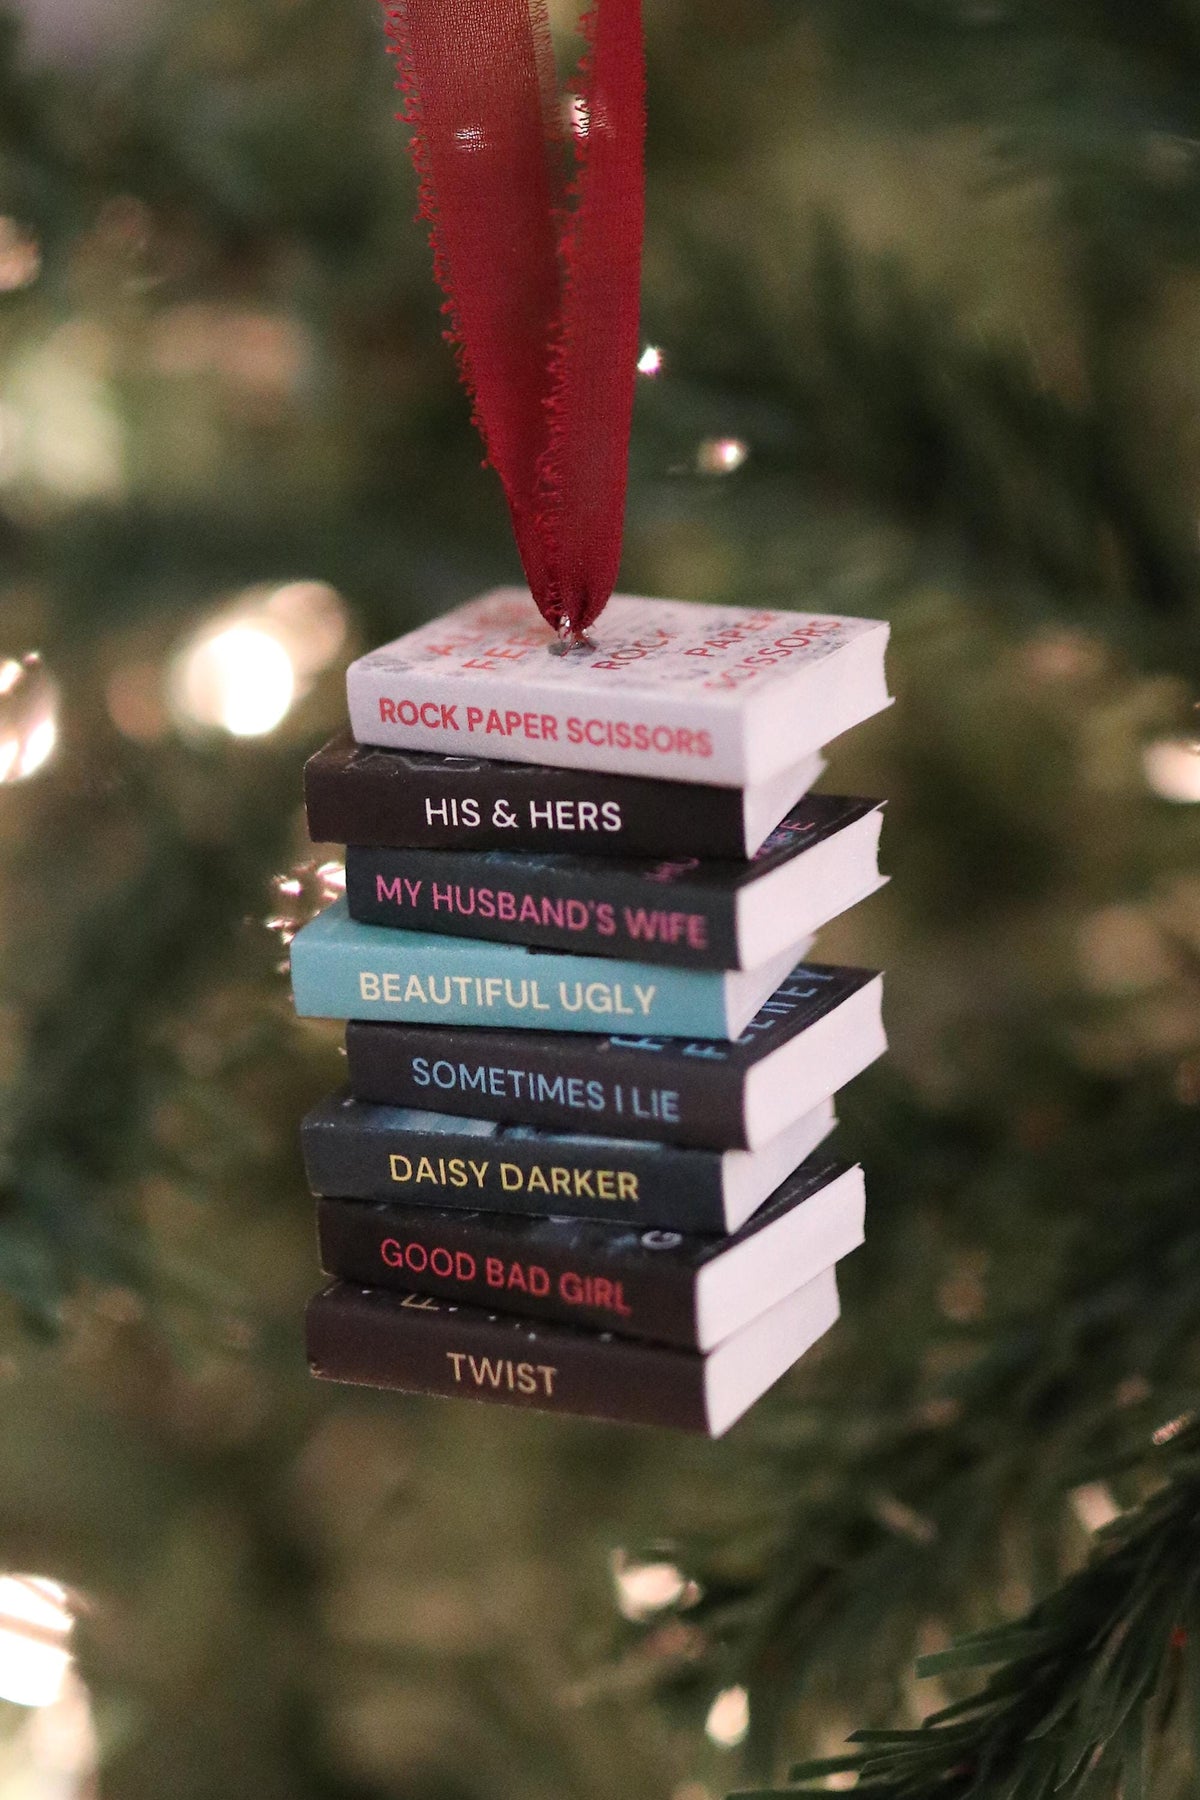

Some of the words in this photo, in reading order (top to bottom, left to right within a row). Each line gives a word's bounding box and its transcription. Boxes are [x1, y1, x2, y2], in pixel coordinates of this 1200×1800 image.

[591, 628, 678, 670] ROCK
[684, 612, 778, 658] PAPER
[703, 621, 842, 690] SCISSORS
[378, 697, 460, 731] ROCK
[466, 706, 558, 741] PAPER
[566, 717, 714, 758] SCISSORS
[425, 798, 480, 828] HIS
[492, 799, 519, 828] &
[530, 800, 622, 832] HERS
[375, 874, 422, 907] MY
[431, 881, 617, 936] HUSBAND'S
[625, 906, 708, 949] WIFE
[359, 971, 550, 1011] BEAUTIFUL
[560, 981, 656, 1015] UGLY
[411, 1057, 605, 1111] SOMETIMES
[613, 1084, 623, 1115] I
[631, 1087, 680, 1123] LIE
[389, 1154, 489, 1188] DAISY
[501, 1162, 640, 1201] DARKER
[380, 1238, 477, 1281] GOOD
[486, 1257, 550, 1297] BAD
[559, 1271, 632, 1318] GIRL
[446, 1351, 557, 1397] TWIST
